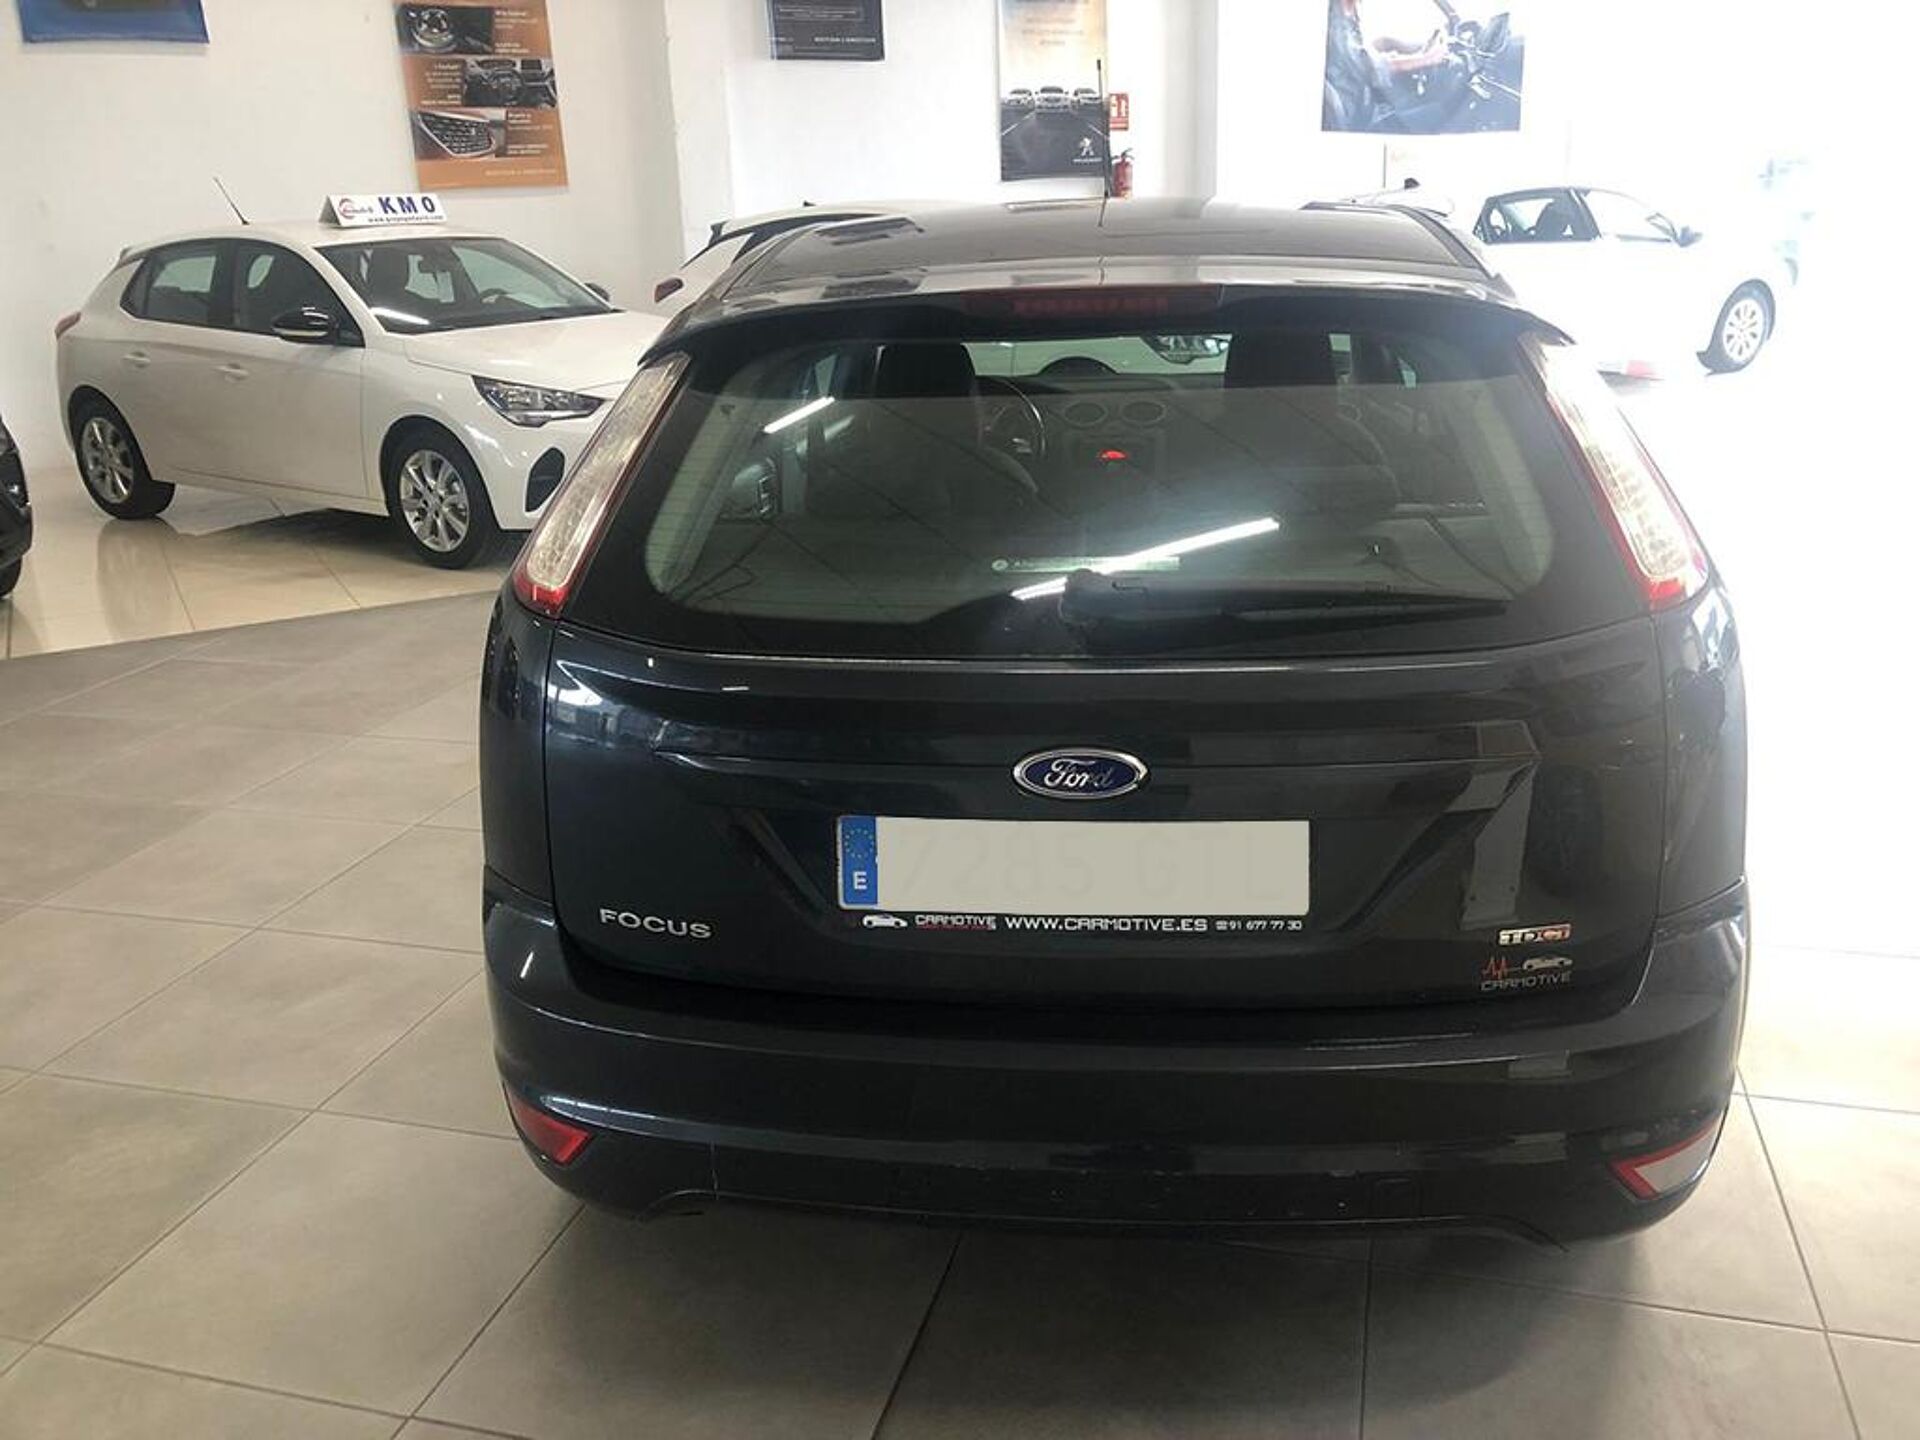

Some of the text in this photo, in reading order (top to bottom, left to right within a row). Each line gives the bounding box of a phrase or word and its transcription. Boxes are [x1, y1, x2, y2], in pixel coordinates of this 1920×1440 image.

[1044, 758, 1114, 788] Ford
[853, 871, 868, 890] E
[599, 907, 712, 939] FOCUS
[914, 914, 997, 926] CARMOTIVE
[1004, 916, 1209, 932] WWW.CARMOTIVE.ES
[1480, 971, 1573, 992] CARMOTIVE
